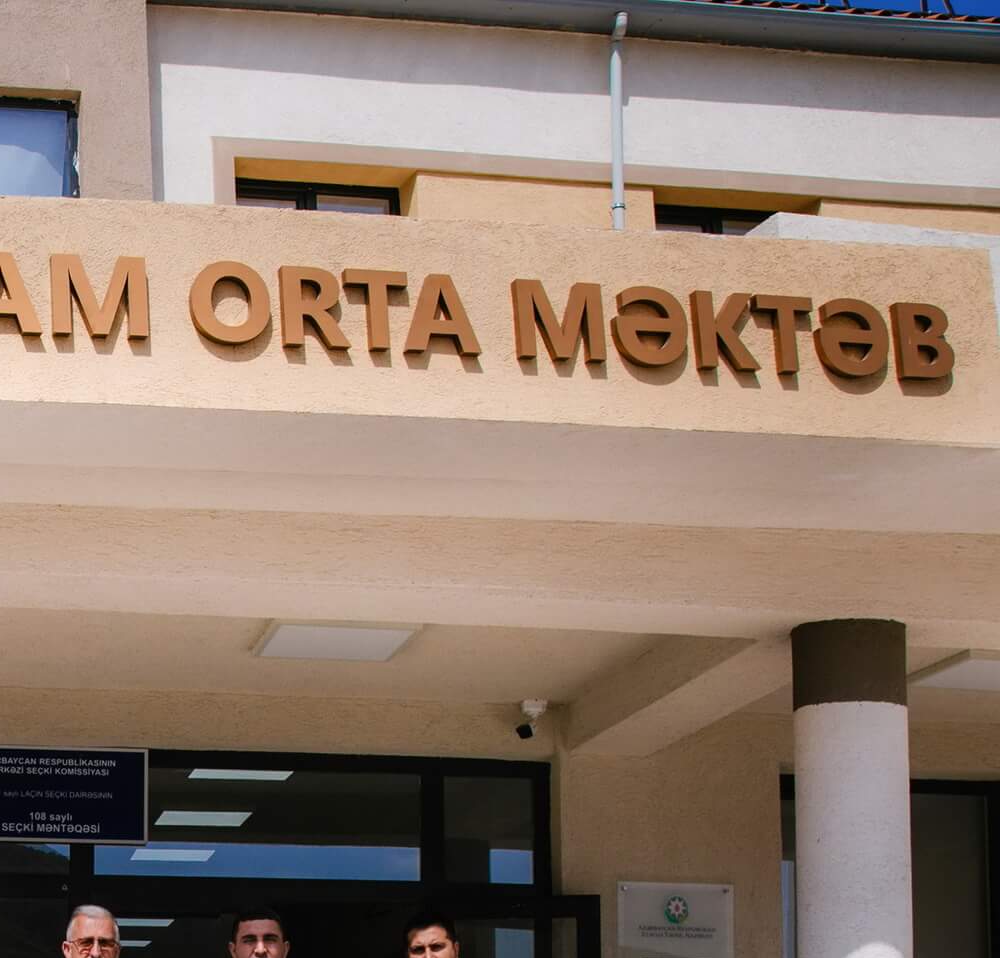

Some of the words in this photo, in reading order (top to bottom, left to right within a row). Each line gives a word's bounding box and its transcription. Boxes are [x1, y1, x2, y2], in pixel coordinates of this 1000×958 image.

[189, 260, 482, 358] ORTA
[510, 278, 955, 381] MƏKTƏB
[29, 811, 47, 821] 108
[49, 812, 73, 824] saylı
[1, 821, 34, 834] SEÇKİ
[36, 822, 101, 834] MƏNTƏQƏSİ
